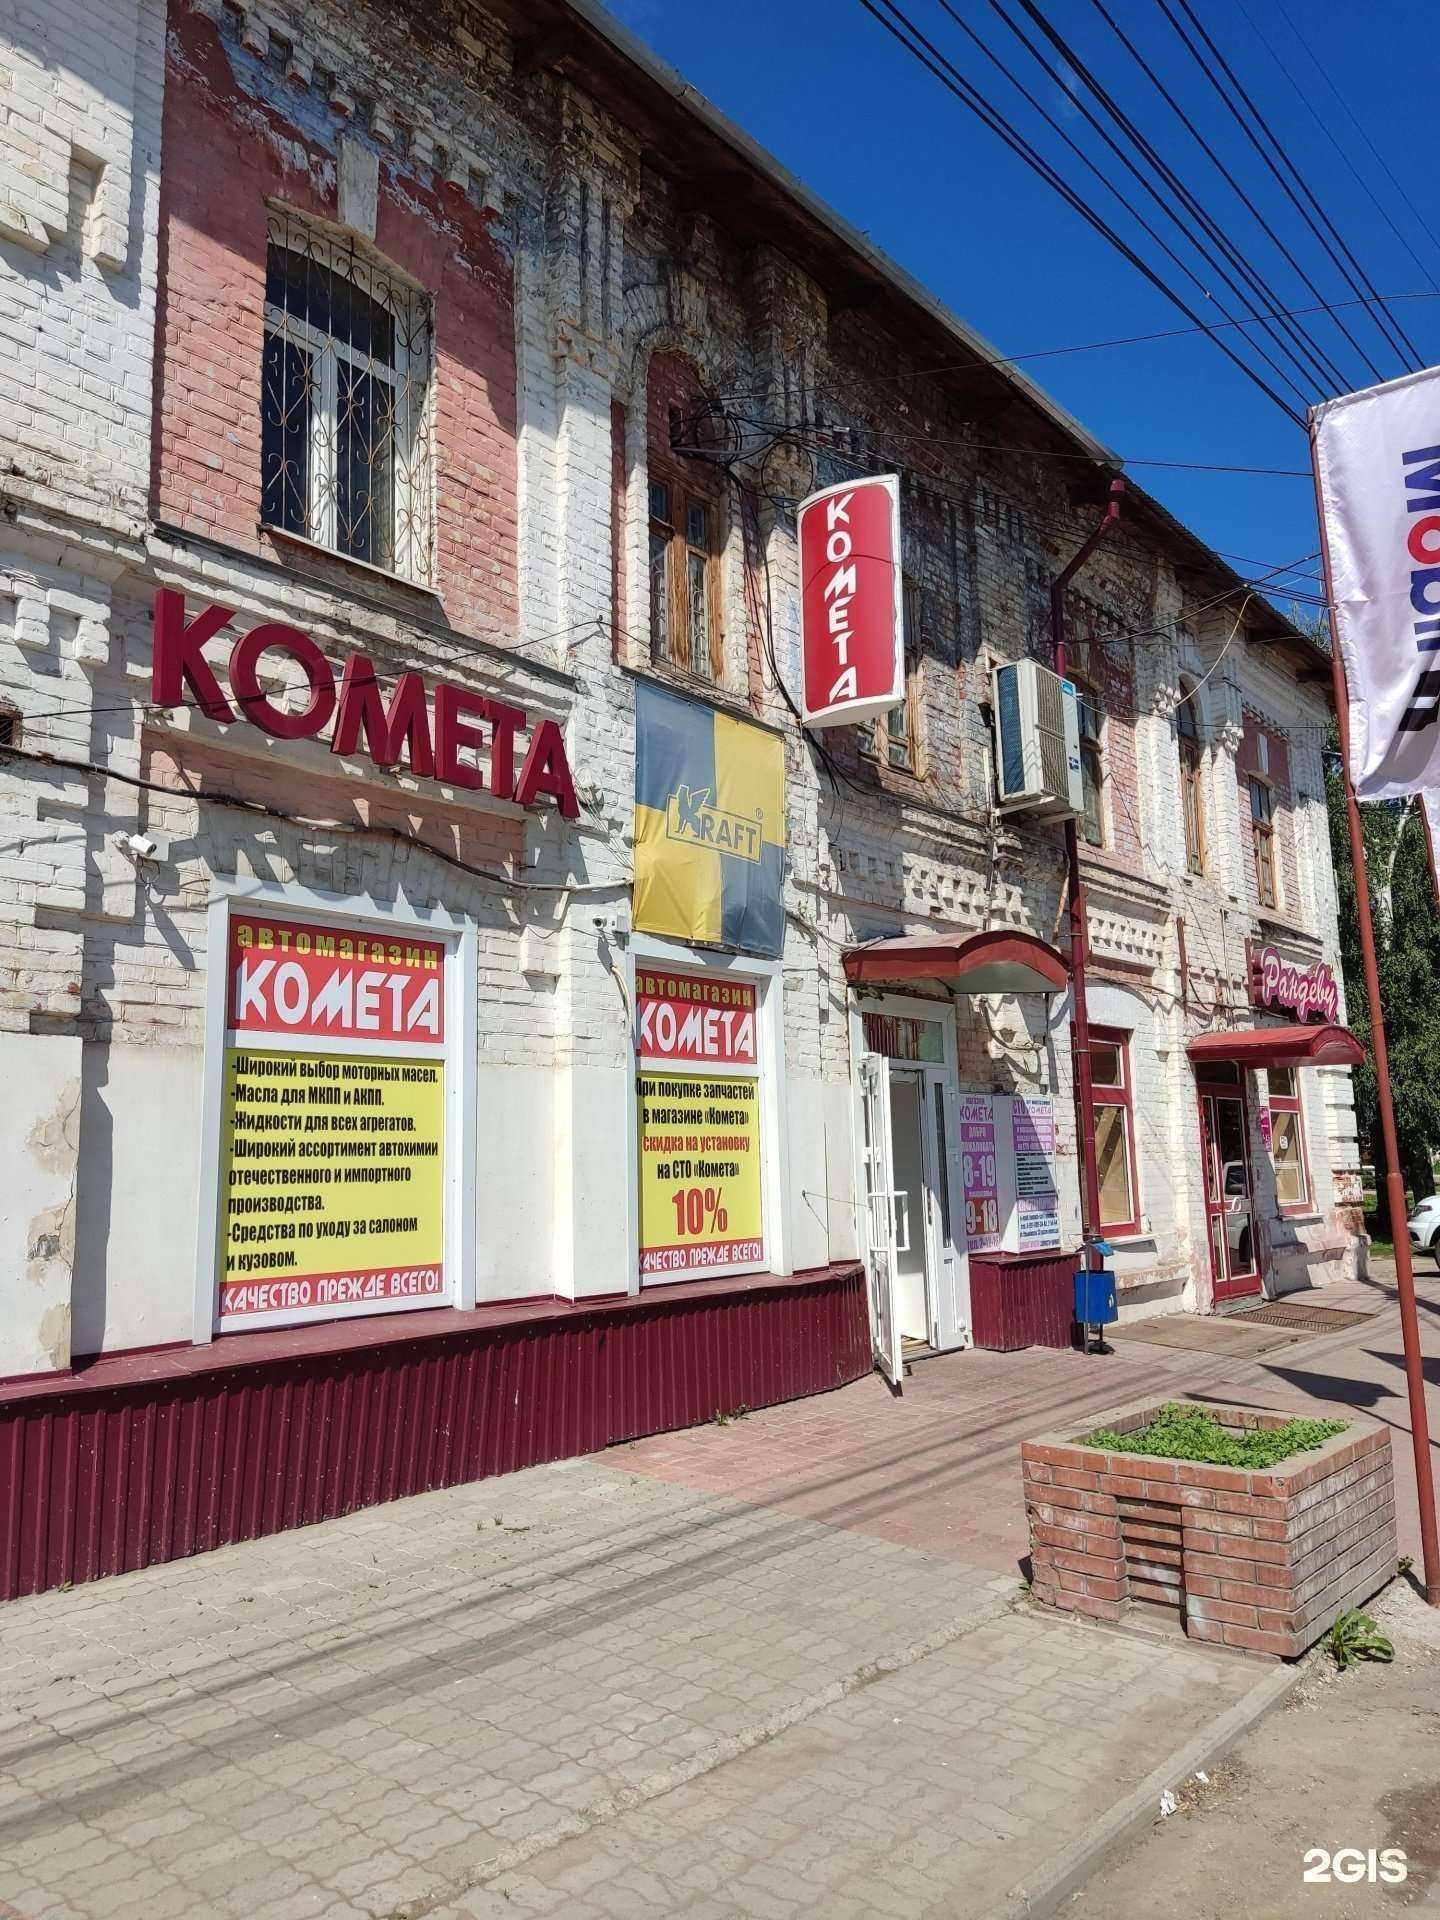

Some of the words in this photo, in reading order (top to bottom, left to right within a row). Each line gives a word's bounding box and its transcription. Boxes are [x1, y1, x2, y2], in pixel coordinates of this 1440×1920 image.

[824, 492, 858, 705] КОМЕТА
[152, 587, 581, 818] КОМЕТА
[675, 784, 757, 854] KRAFT
[237, 924, 438, 970] автомагазин
[236, 957, 439, 1035] КОМЕТА
[636, 974, 753, 1007] автомагазин
[1262, 951, 1338, 1021] Рандеву
[635, 1001, 754, 1058] КОМЕТА
[232, 1056, 297, 1077] -Широкий
[300, 1061, 340, 1080] выбор
[342, 1064, 400, 1081] моторных
[402, 1067, 438, 1083] масел.
[231, 1084, 278, 1103] -Масла
[281, 1088, 305, 1106] для
[308, 1086, 341, 1105] МКПП
[343, 1090, 351, 1104] и
[353, 1088, 384, 1105] АКПП.
[636, 1077, 656, 1098] При
[658, 1081, 701, 1099] покупке
[704, 1082, 754, 1100] запчастей
[230, 1111, 302, 1132] -Жидкости
[305, 1115, 328, 1133] для
[331, 1116, 358, 1131] всех
[360, 1116, 416, 1132] агрегатов.
[642, 1108, 650, 1123] в
[652, 1108, 702, 1124] магазине
[705, 1107, 749, 1125] «Комета»
[230, 1138, 296, 1159] -Широкий
[298, 1142, 377, 1158] ассортимент
[379, 1142, 438, 1156] автохимии
[643, 1136, 684, 1154] скидка
[686, 1136, 698, 1151] на
[700, 1136, 750, 1152] установку
[229, 1168, 332, 1185] отечественного
[334, 1168, 342, 1183] и
[344, 1167, 411, 1183] импортного
[657, 1164, 670, 1179] на
[672, 1160, 692, 1179] СТО
[694, 1160, 739, 1178] «Комета»
[963, 1154, 996, 1188] 8-19
[228, 1195, 325, 1215] производства.
[672, 1187, 728, 1235] 10%
[965, 1199, 998, 1234] 9-18
[227, 1222, 296, 1244] -Средства
[298, 1222, 313, 1238] по
[316, 1220, 351, 1239] уходу
[353, 1220, 366, 1234] за
[369, 1217, 418, 1234] салоном
[227, 1255, 235, 1271] и
[238, 1251, 298, 1271] кузовом.
[690, 1244, 730, 1266] ПРЕЖДЕ
[222, 1281, 311, 1312] КАЧЕСТВО
[317, 1274, 386, 1303] ПРЕЖДЕ
[391, 1269, 439, 1295] ВСЕГО!
